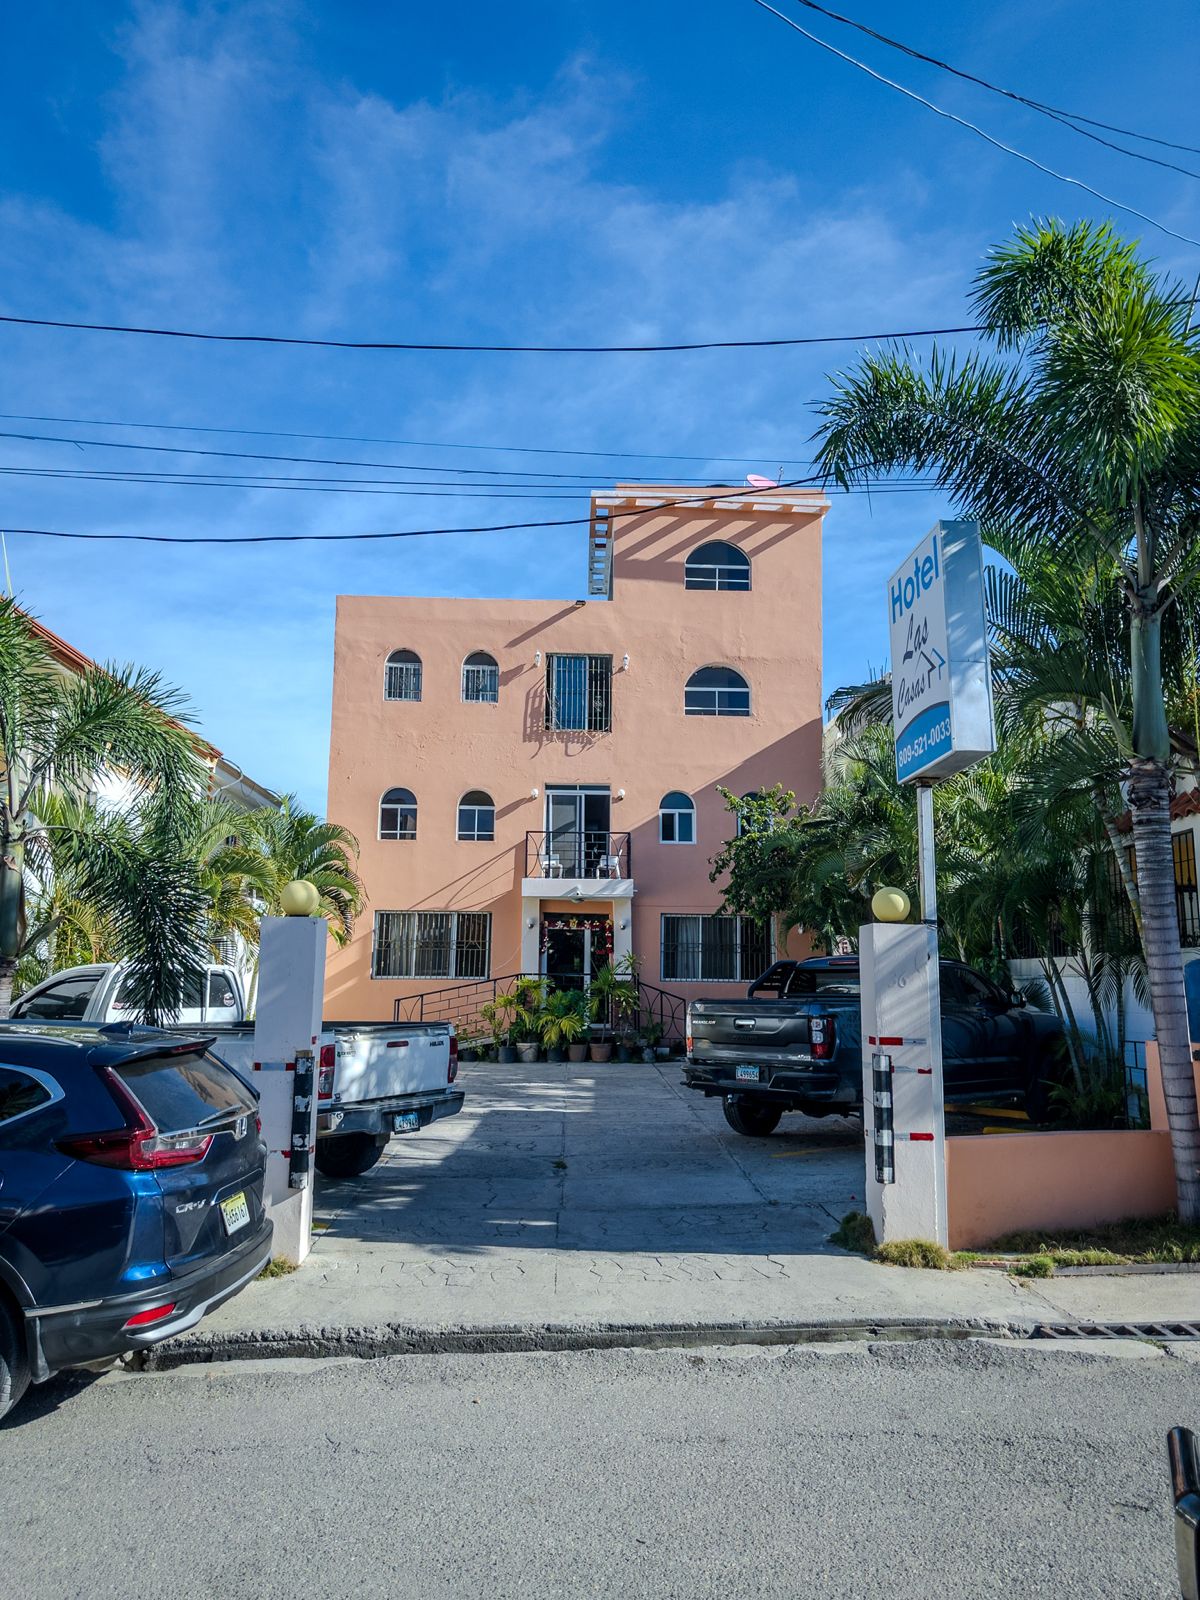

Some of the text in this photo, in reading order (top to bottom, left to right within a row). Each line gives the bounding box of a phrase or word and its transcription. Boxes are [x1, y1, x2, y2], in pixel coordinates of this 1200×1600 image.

[891, 534, 939, 624] Hotel
[902, 613, 928, 664] Las
[897, 673, 926, 719] Casas
[898, 718, 950, 767] 809-521-0033
[175, 1199, 207, 1214] CR-V
